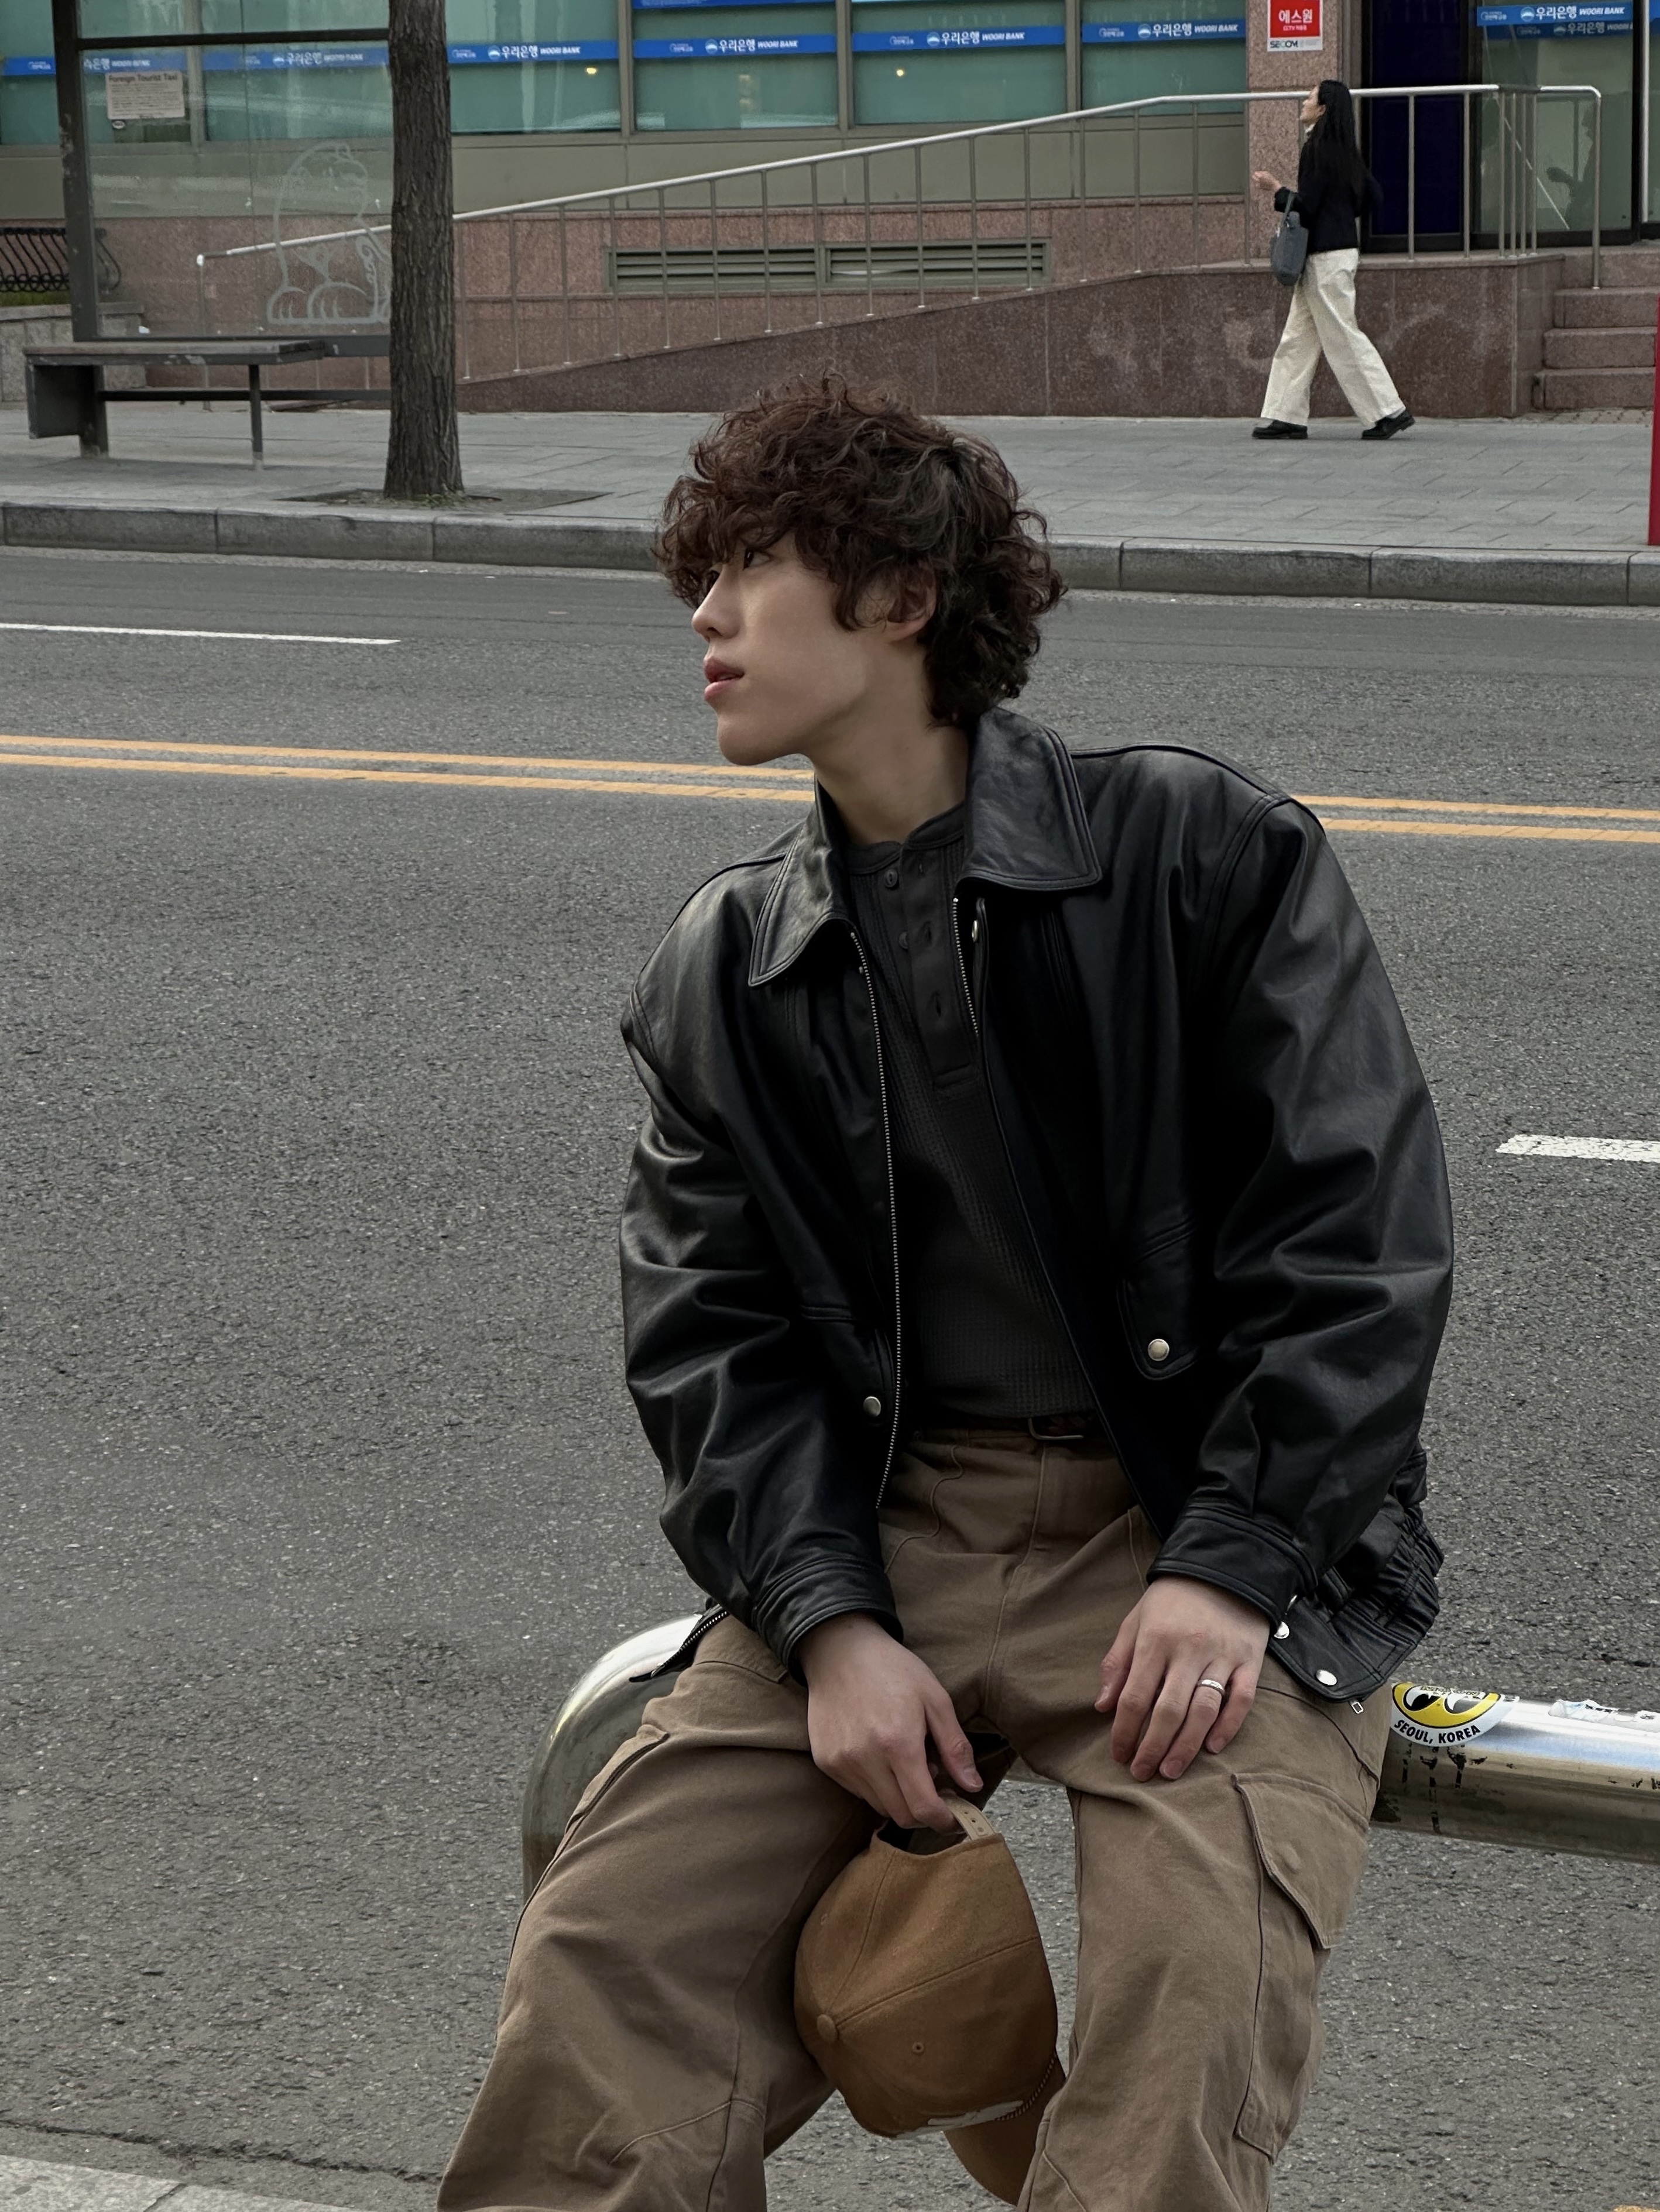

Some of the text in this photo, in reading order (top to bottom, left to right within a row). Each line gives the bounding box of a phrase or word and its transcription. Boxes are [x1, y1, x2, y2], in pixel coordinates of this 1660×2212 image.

[1278, 9, 1312, 24] 에스원
[1535, 5, 1625, 20] 우리은행 WOORI BANK
[1153, 23, 1192, 37] 우리은행
[1195, 25, 1217, 33] WOORI
[1568, 22, 1605, 34] 우리은행
[942, 31, 980, 46] 우리은행
[502, 45, 539, 59] 우리은행
[719, 39, 756, 53] 우리은행
[780, 40, 798, 48] BANK
[109, 74, 135, 84] Foreign
[1394, 1719, 1481, 1744] SEOUL, KOREA
